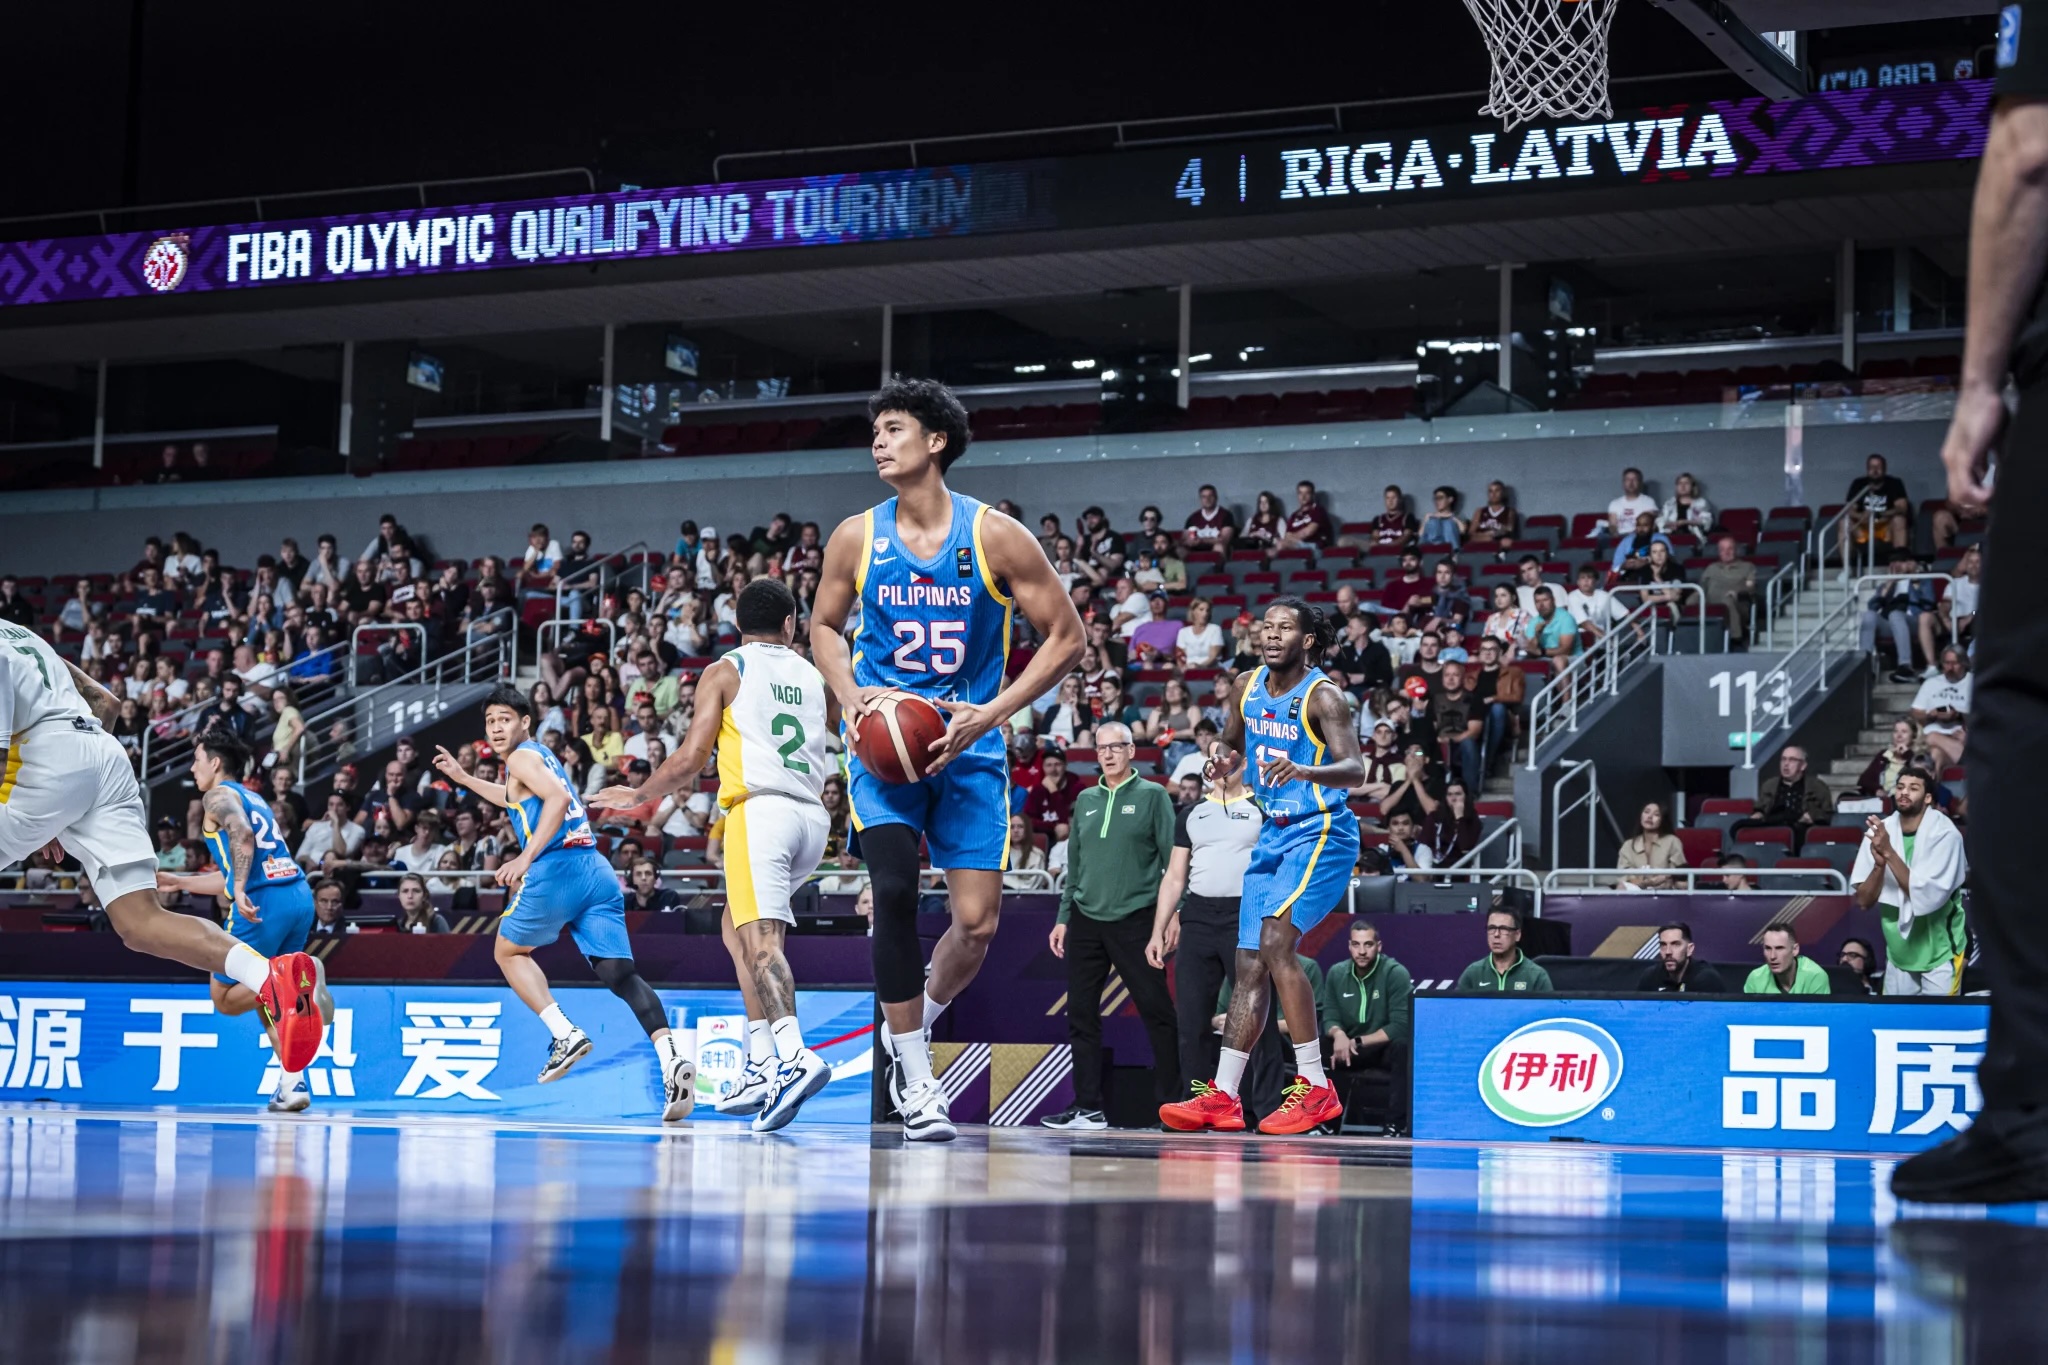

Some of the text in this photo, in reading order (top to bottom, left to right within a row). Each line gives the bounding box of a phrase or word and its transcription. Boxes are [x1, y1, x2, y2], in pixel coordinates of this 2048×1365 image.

[1176, 158, 1205, 206] 4
[227, 229, 312, 282] FIBA
[326, 214, 495, 275] OLYMPIC
[511, 194, 750, 262] QUALIFYING
[878, 584, 971, 606] PILIPINAS
[12, 645, 53, 690] 7
[892, 620, 966, 674] 25
[770, 683, 803, 706] YAGO
[1709, 670, 1793, 716] 113
[771, 712, 811, 775] 2
[1245, 716, 1299, 741] PILIPINAS
[701, 1050, 736, 1069] 纯牛奶
[1501, 1052, 1598, 1093] 伊利
[1722, 1024, 1988, 1135] 品质
